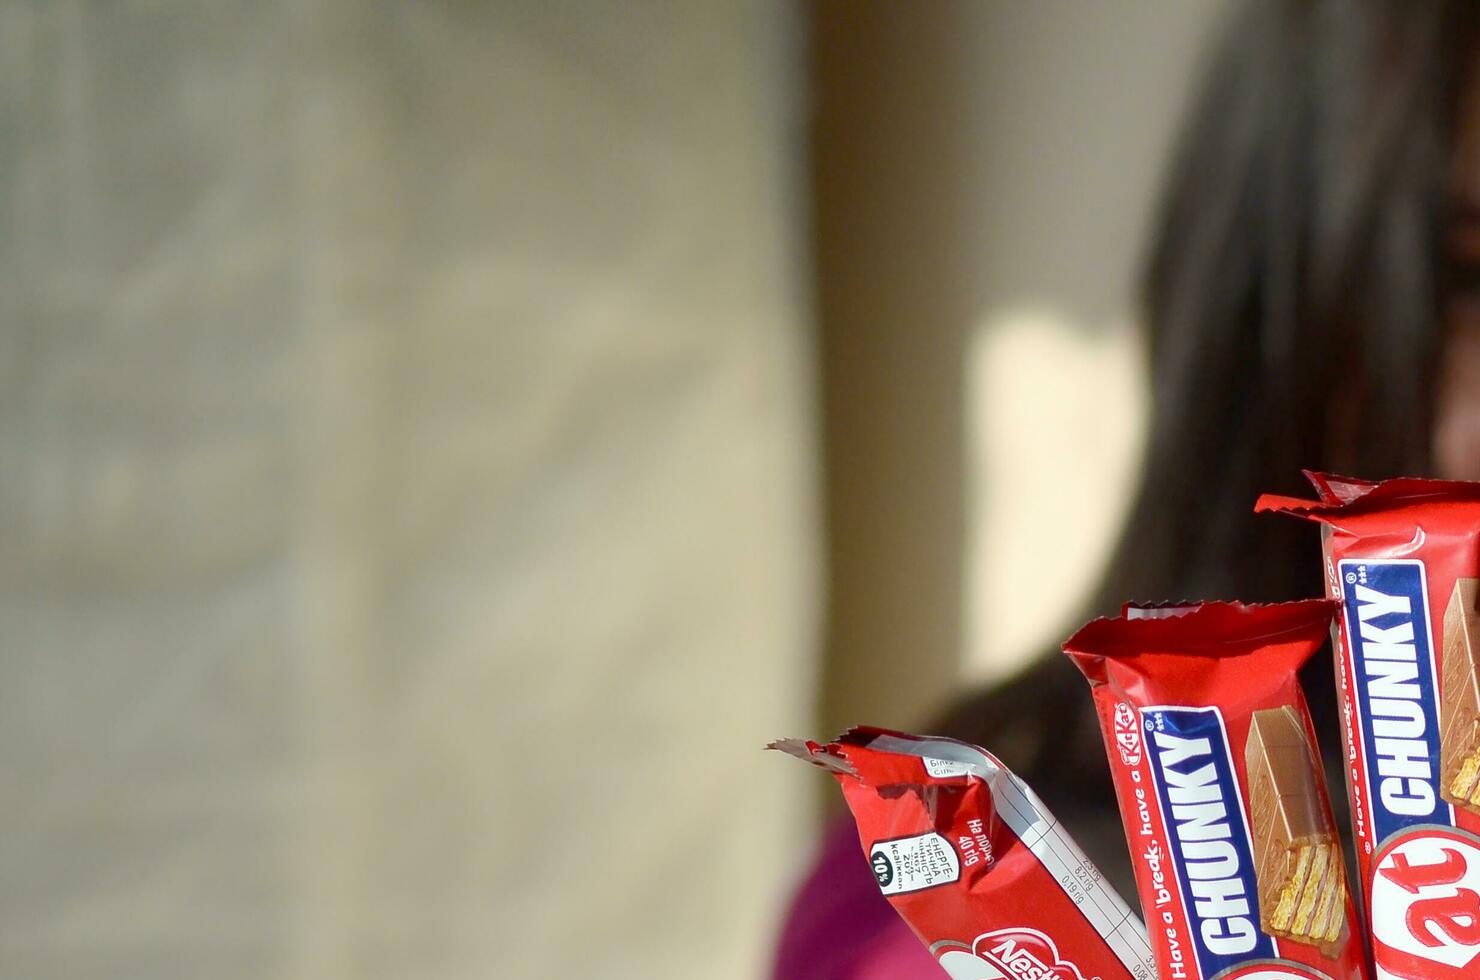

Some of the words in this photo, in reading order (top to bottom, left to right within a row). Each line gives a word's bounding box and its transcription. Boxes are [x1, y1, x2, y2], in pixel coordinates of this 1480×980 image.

[1355, 584, 1436, 816] CHUNKY
[1115, 703, 1142, 766] KitKat
[1131, 770, 1141, 783] a
[967, 818, 982, 835] На
[1134, 788, 1153, 836] have
[1355, 785, 1366, 837] Have
[924, 843, 941, 877] ТИЧНА
[930, 837, 954, 879] ЕНЕРГЕ-
[959, 836, 974, 853] 40
[1153, 731, 1257, 955] CHUNKY
[873, 856, 889, 882] 10%
[1062, 875, 1078, 894] 0,19
[1074, 866, 1086, 881] 8,2
[1162, 911, 1174, 925] a
[1167, 928, 1187, 978] Have
